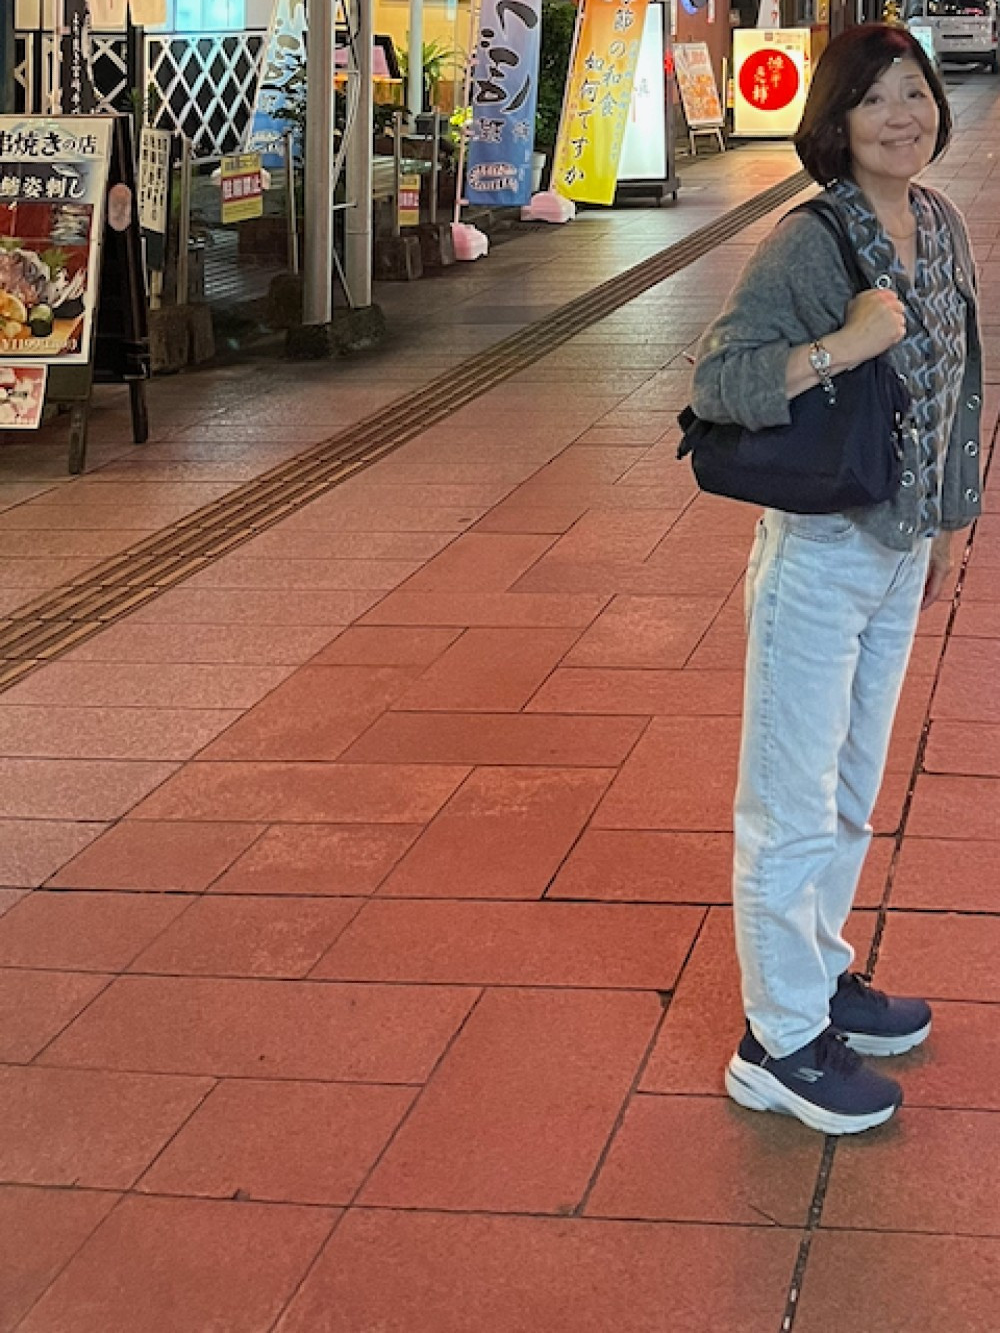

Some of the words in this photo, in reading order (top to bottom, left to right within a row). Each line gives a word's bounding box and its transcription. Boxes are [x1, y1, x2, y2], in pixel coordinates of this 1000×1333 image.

[563, 52, 606, 186] 如何ですか
